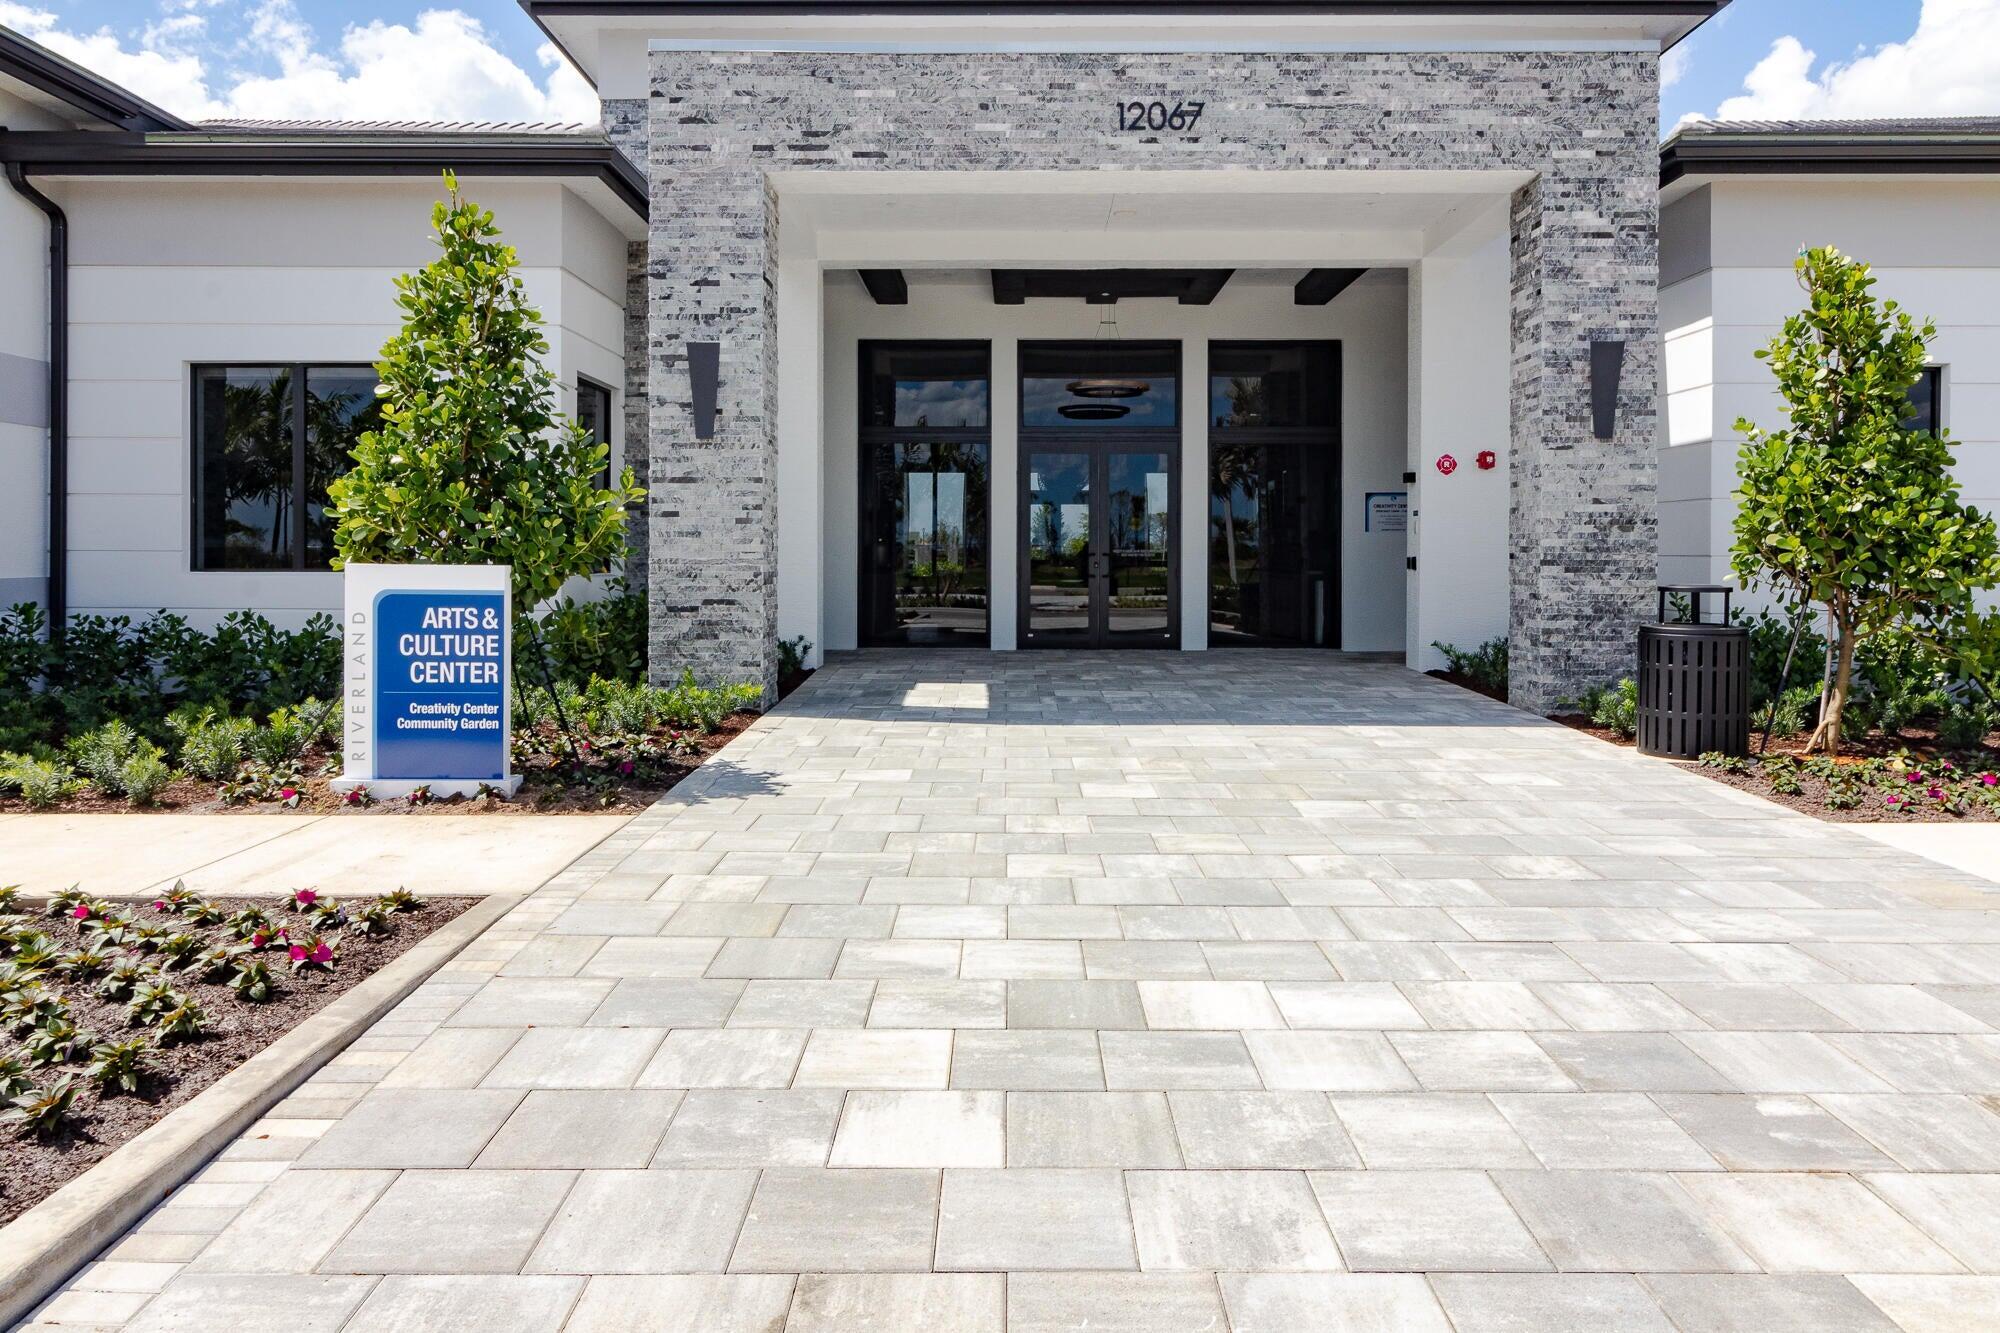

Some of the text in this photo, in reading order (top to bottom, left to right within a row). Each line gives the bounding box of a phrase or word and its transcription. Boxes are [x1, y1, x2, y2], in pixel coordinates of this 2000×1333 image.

[1116, 102, 1205, 131] 12067
[422, 607, 499, 630] ARTS &
[399, 634, 499, 657] CULTURE
[410, 661, 499, 684] CENTER
[351, 611, 366, 761] RIVERLAND
[409, 702, 499, 716] Creativity Center
[397, 718, 499, 731] Community Garden
